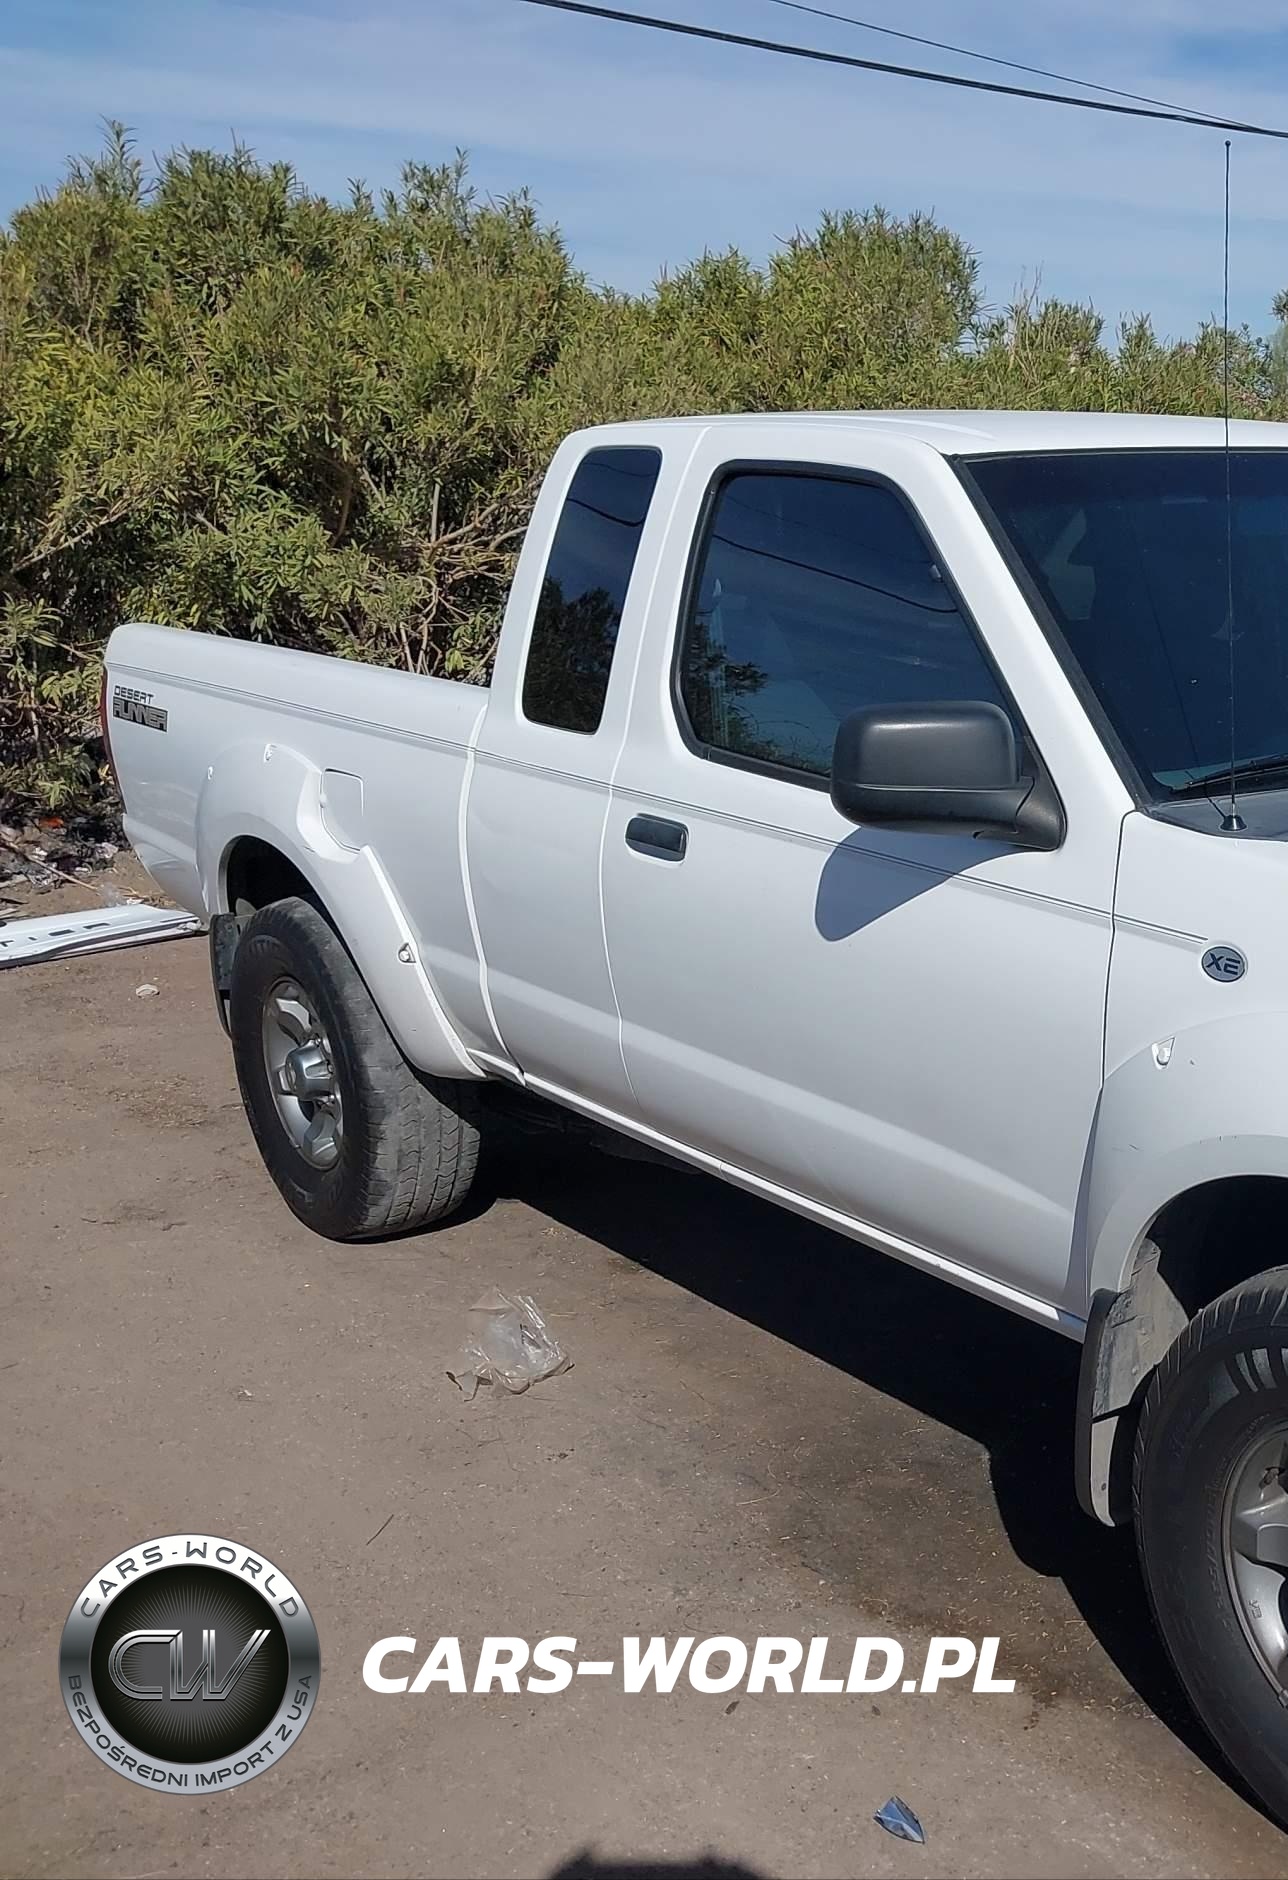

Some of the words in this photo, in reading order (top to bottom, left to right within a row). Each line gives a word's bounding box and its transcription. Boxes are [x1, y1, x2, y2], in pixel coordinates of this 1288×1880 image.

[114, 685, 154, 704] DESERT
[113, 696, 168, 732] RUNNER
[1206, 952, 1241, 976] XE
